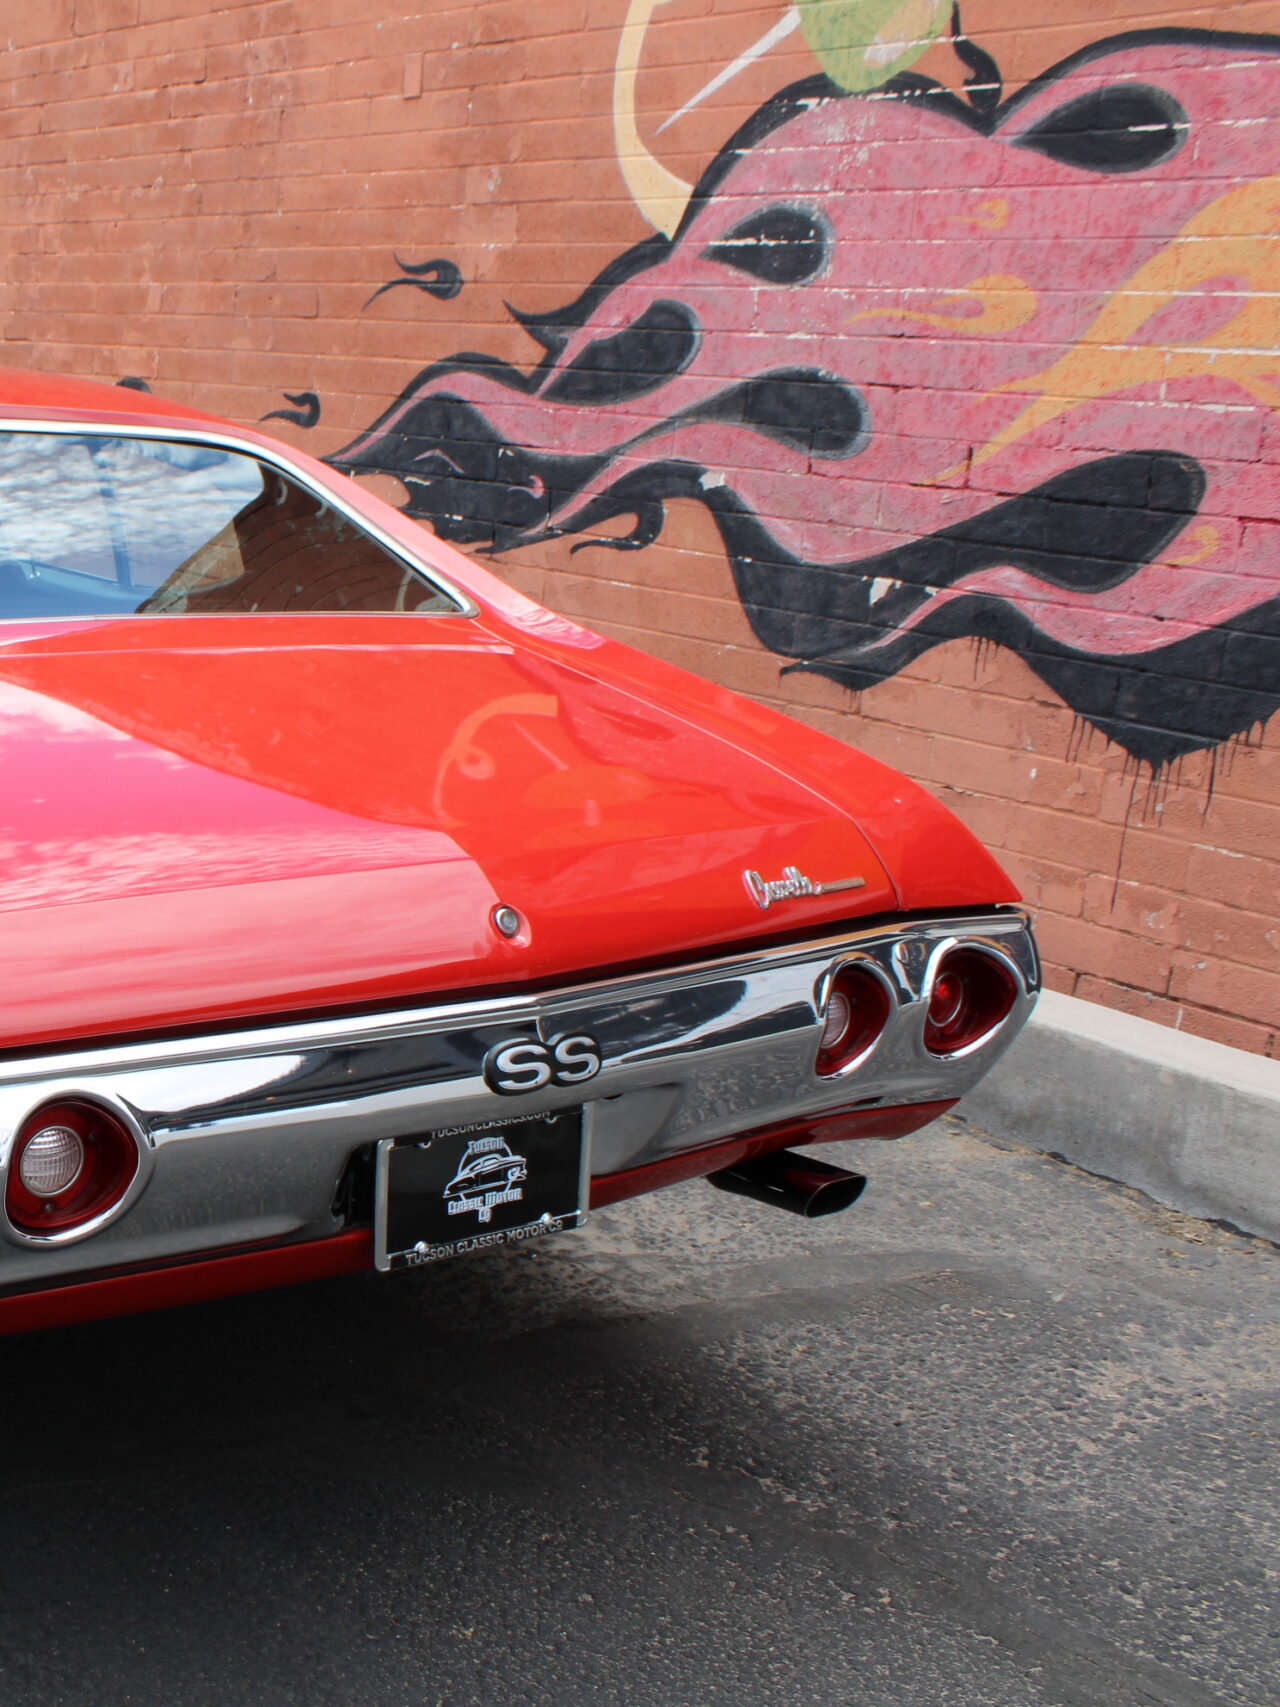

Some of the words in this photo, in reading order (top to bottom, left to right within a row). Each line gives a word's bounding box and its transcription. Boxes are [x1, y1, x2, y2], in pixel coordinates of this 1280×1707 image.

[495, 1034, 600, 1091] SS
[468, 1136, 505, 1155] TUCSON
[447, 1196, 484, 1215] CLASSIC
[484, 1188, 523, 1208] MOTOR
[405, 1243, 455, 1266] TUCSON
[456, 1233, 504, 1253] CLASSIC
[506, 1223, 547, 1242] MOTOR
